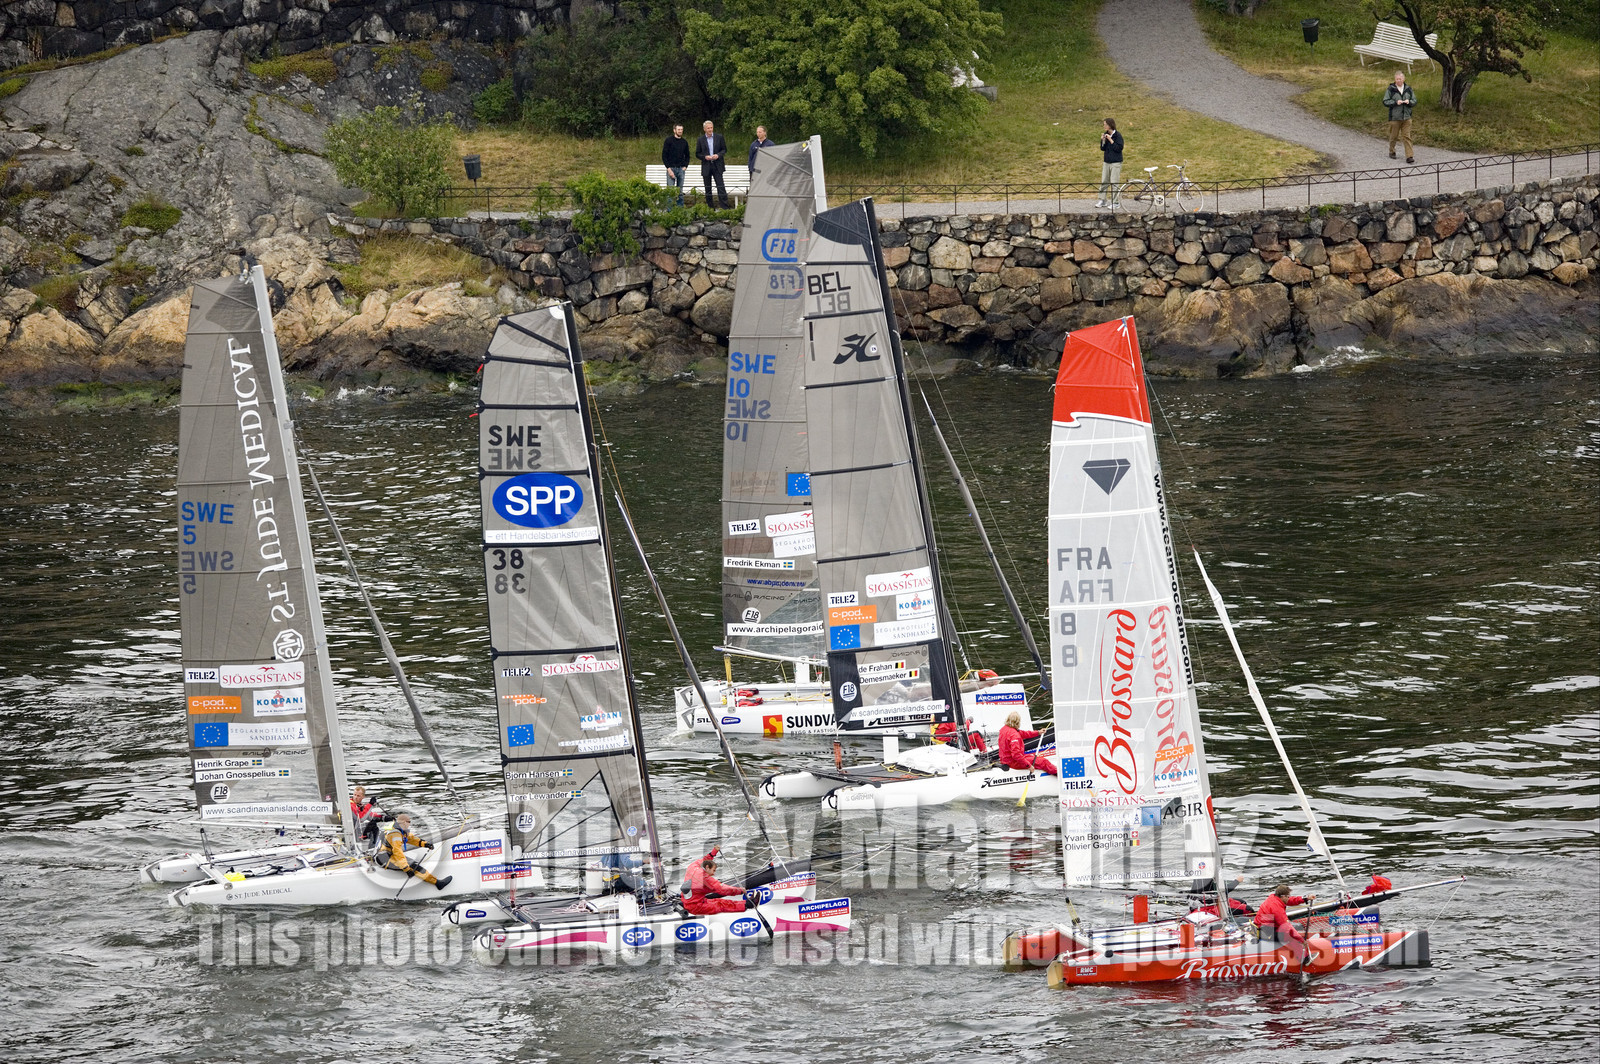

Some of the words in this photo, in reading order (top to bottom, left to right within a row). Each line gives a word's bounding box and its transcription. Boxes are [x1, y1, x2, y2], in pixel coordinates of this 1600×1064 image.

[770, 238, 796, 254] F18
[808, 271, 851, 295] BEL
[730, 352, 776, 374] SWE
[730, 378, 750, 398] 10
[488, 425, 542, 447] SWE
[505, 485, 576, 516] SPP
[181, 502, 234, 524] SWE
[732, 522, 757, 532] TELE2
[183, 525, 196, 544] 5
[492, 549, 524, 570] 38
[727, 558, 752, 567] Fredrik
[754, 560, 780, 568] Ekman
[1057, 547, 1112, 571] FRA
[1153, 474, 1192, 685] www.team-ocean.com
[830, 594, 856, 604] TELE2
[745, 610, 760, 620] F18
[732, 622, 824, 634] www.archipelagoraid
[1060, 612, 1076, 636] 8
[502, 668, 531, 677] TELE2
[858, 666, 868, 674] de
[869, 664, 892, 672] Frahan
[188, 671, 216, 680] TELE2
[222, 671, 302, 686] SJÖASSISTANS
[860, 672, 906, 684] Demesmaeker
[843, 684, 855, 694] F18
[256, 696, 303, 706] KOMPANI
[1094, 608, 1137, 795] Brossard
[580, 712, 622, 722] KOMPANI
[198, 760, 222, 768] Henrik
[225, 760, 249, 768] Grape
[200, 772, 224, 780] Johan
[226, 770, 276, 779] Gnosspelius
[529, 770, 560, 778] Hansen
[1154, 769, 1198, 781] KOMPANI
[214, 786, 228, 796] F18
[1064, 780, 1093, 790] TELE2
[510, 794, 528, 802] Tore
[530, 792, 568, 800] Lewander
[1062, 796, 1145, 810] SJÖASSISTANS
[206, 805, 329, 815] www.scandinavianislands.com
[1163, 802, 1204, 820] AGIR
[519, 815, 534, 824] F18
[1064, 834, 1085, 842] Yvan
[1088, 832, 1128, 841] Bourgnon
[454, 840, 500, 851] ARCHIPELAGO
[1064, 843, 1090, 851] Olivier
[1093, 840, 1127, 850] Gagliani
[1076, 870, 1202, 882] www.scandinavianislands.com
[244, 892, 260, 900] JUDE
[262, 888, 292, 896] MEDICAL
[800, 900, 847, 912] ARCHIPELAGO
[800, 912, 820, 920] RAID
[678, 926, 704, 938] SPP
[733, 922, 758, 934] SPP
[626, 930, 652, 943] SPP
[1334, 938, 1381, 946] ARCHIPELAGO
[1176, 955, 1288, 979] Brossard
